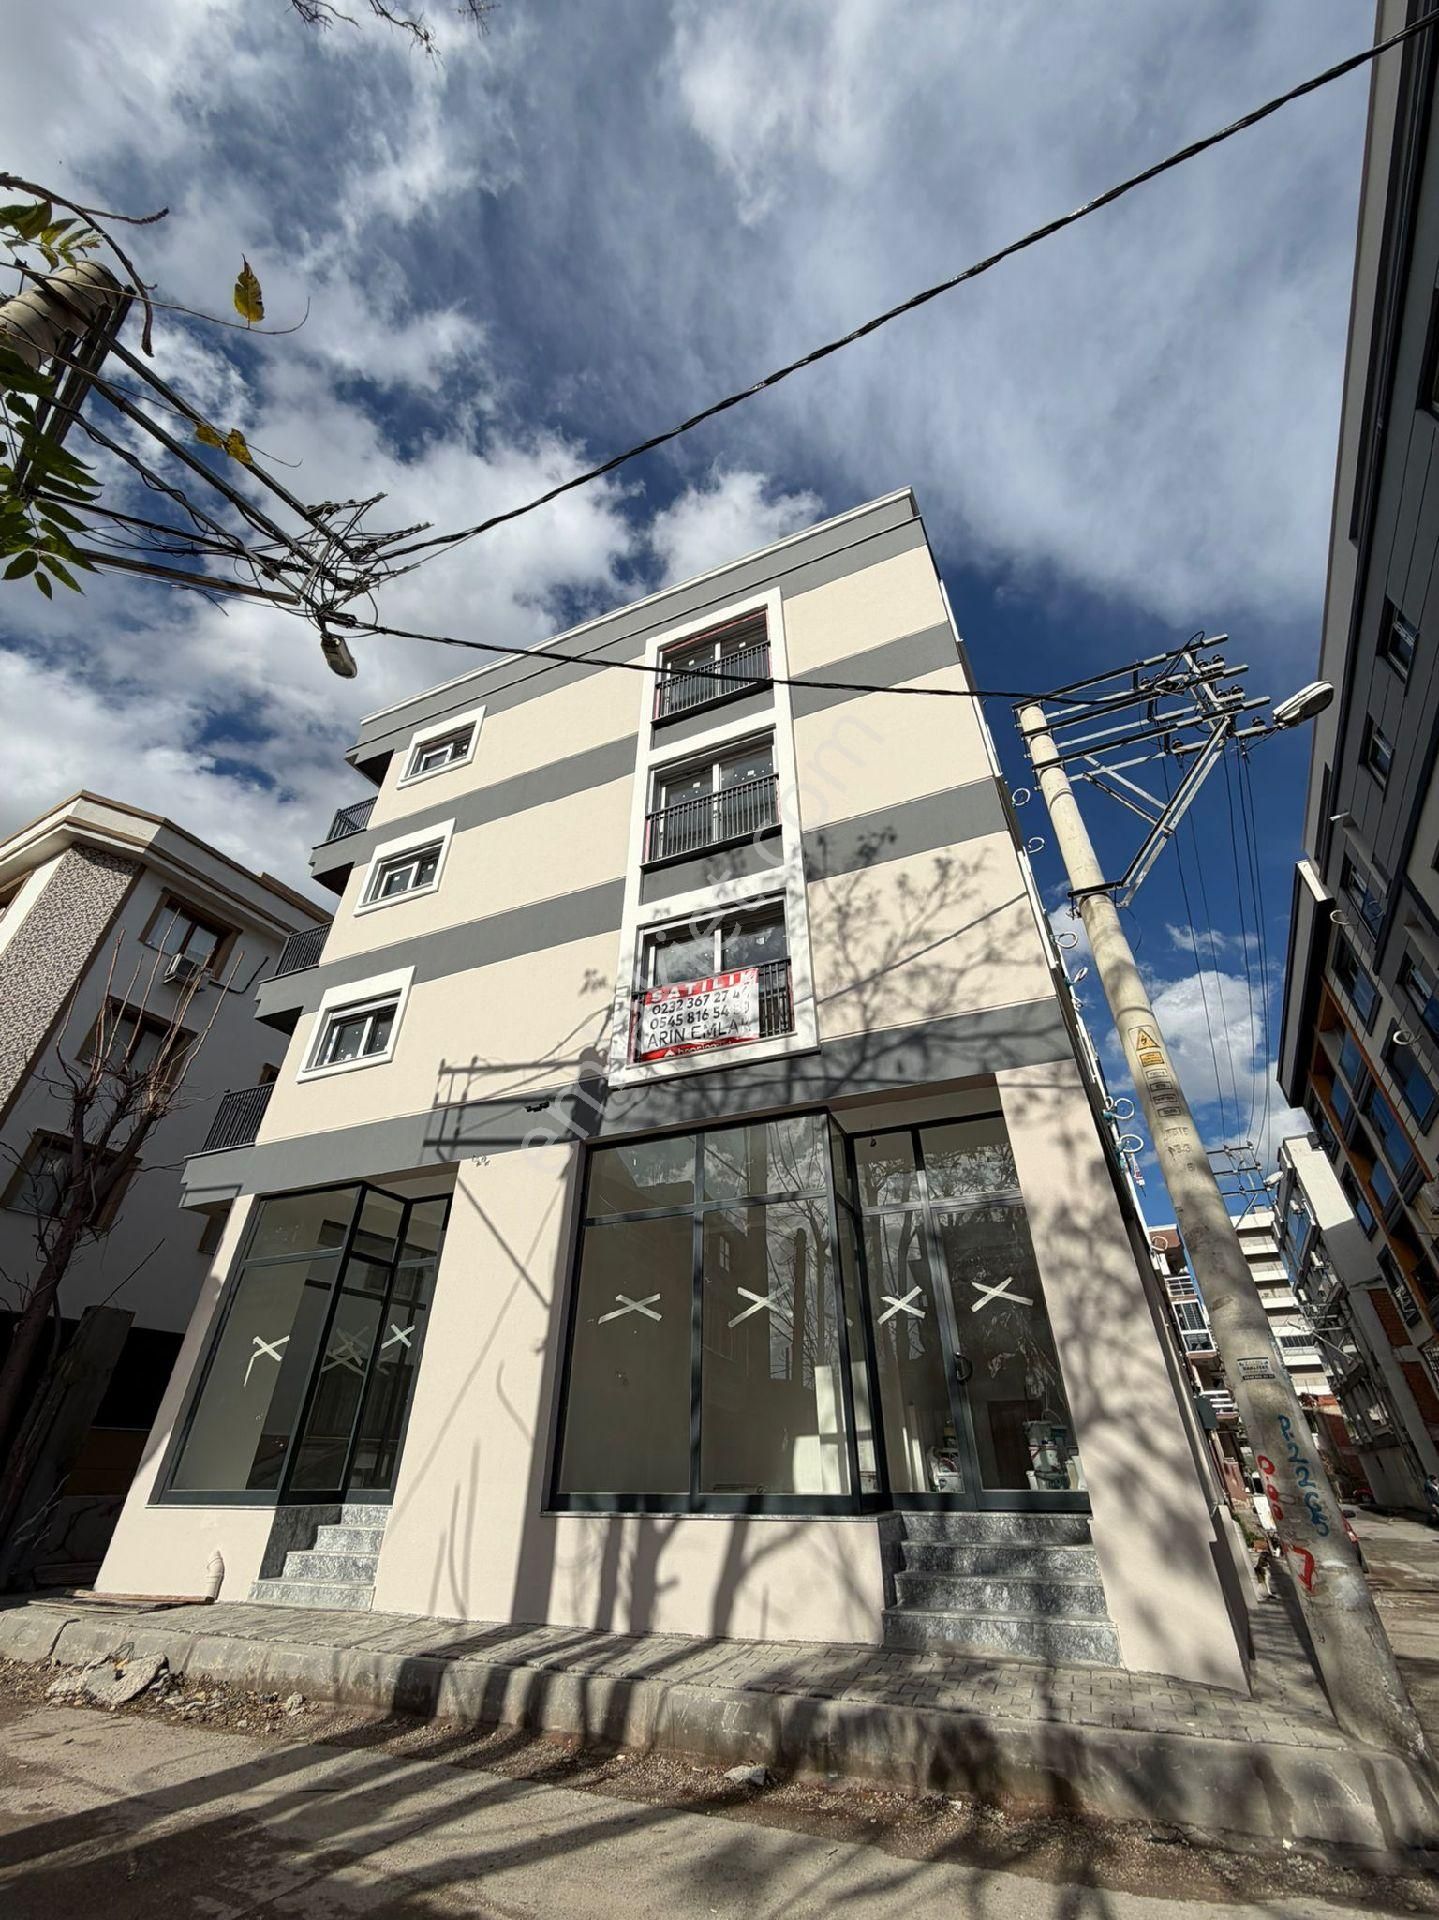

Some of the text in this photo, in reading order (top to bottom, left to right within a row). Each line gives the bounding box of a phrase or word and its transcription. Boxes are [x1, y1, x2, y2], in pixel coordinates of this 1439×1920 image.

[652, 998, 683, 1015] 0232
[687, 994, 710, 1009] 367
[713, 990, 729, 1003] 27
[650, 1013, 684, 1030] 0545
[687, 1009, 710, 1024] 816
[713, 1004, 730, 1019] 54
[648, 1028, 686, 1048] ARIN
[691, 1018, 751, 1041] EMLAK
